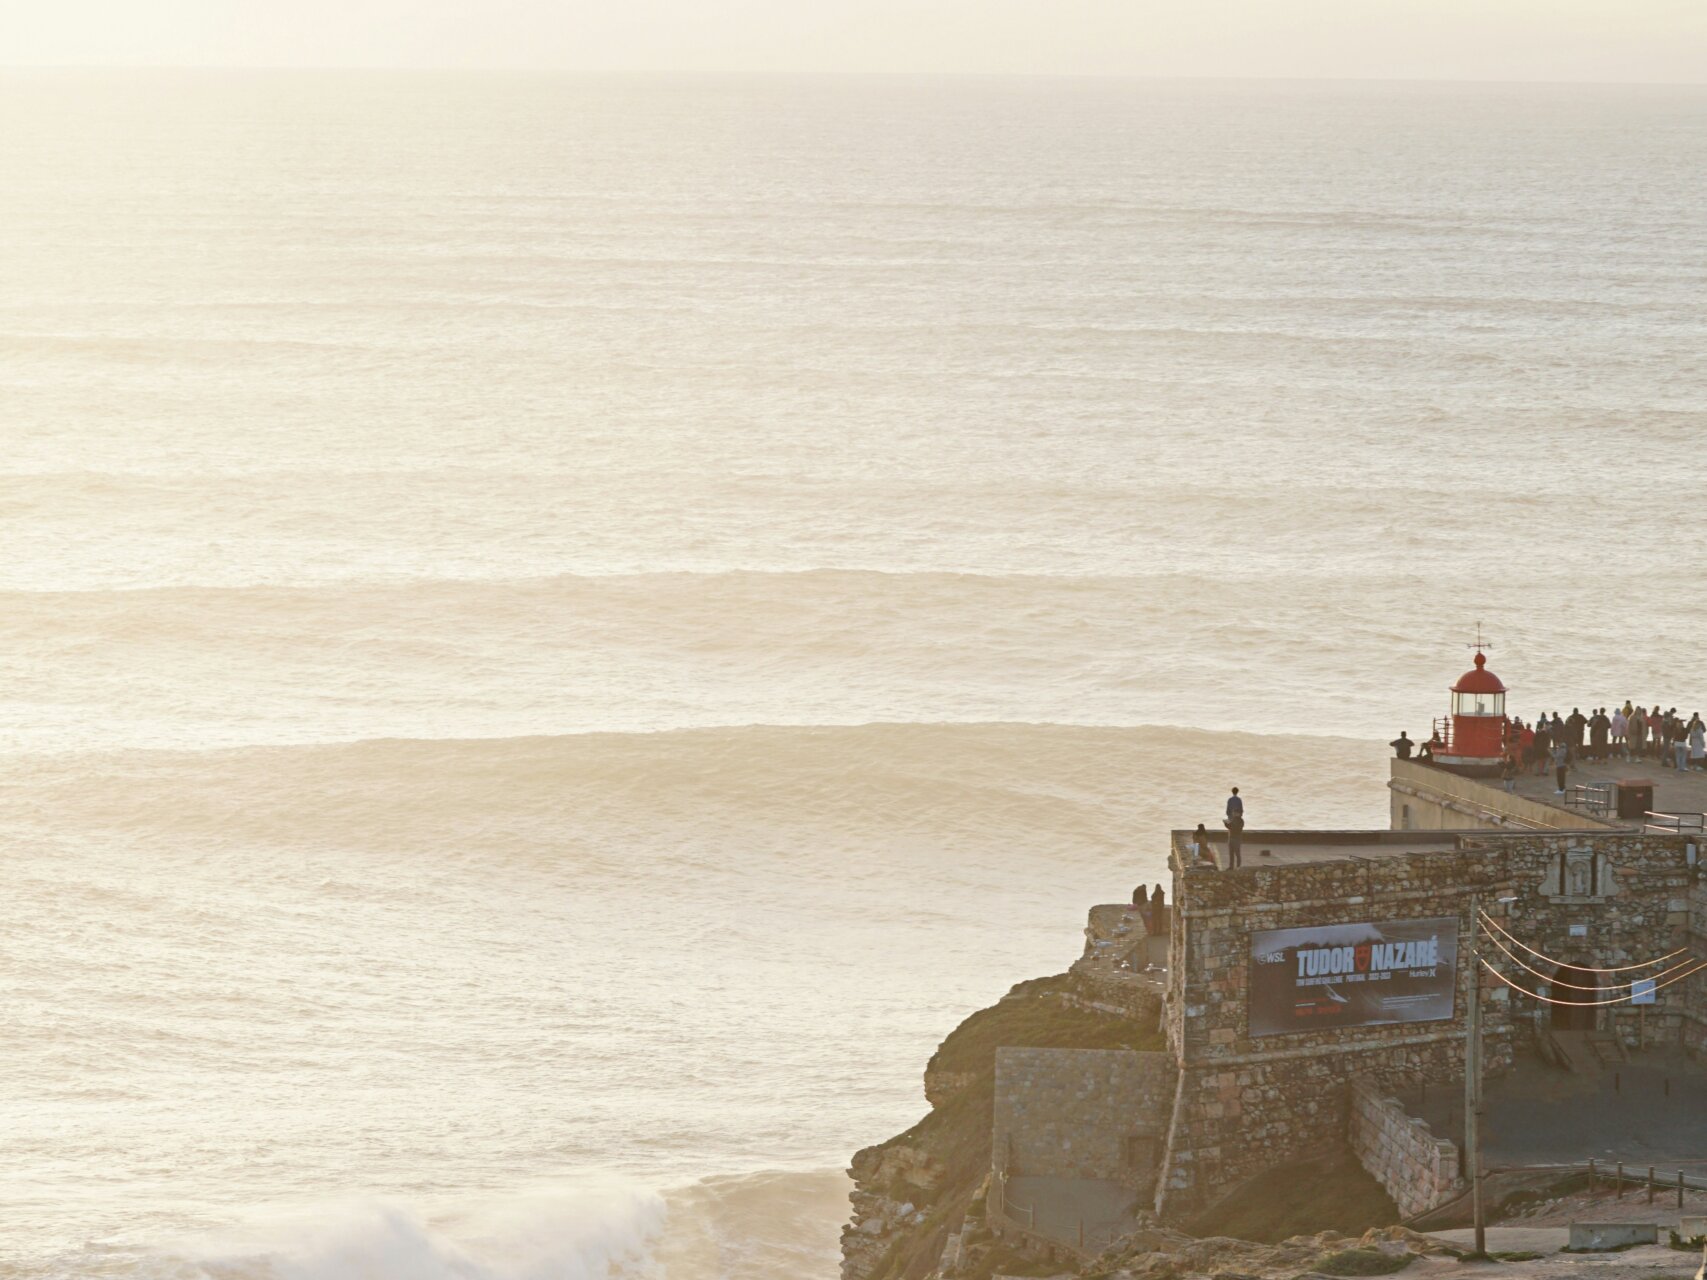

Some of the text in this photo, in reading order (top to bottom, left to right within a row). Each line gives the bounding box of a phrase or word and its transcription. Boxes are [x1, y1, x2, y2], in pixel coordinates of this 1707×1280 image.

[1266, 952, 1286, 963] WSL
[1296, 935, 1438, 977] TUDOR NAZARÉ
[1409, 969, 1429, 978] Hurley
